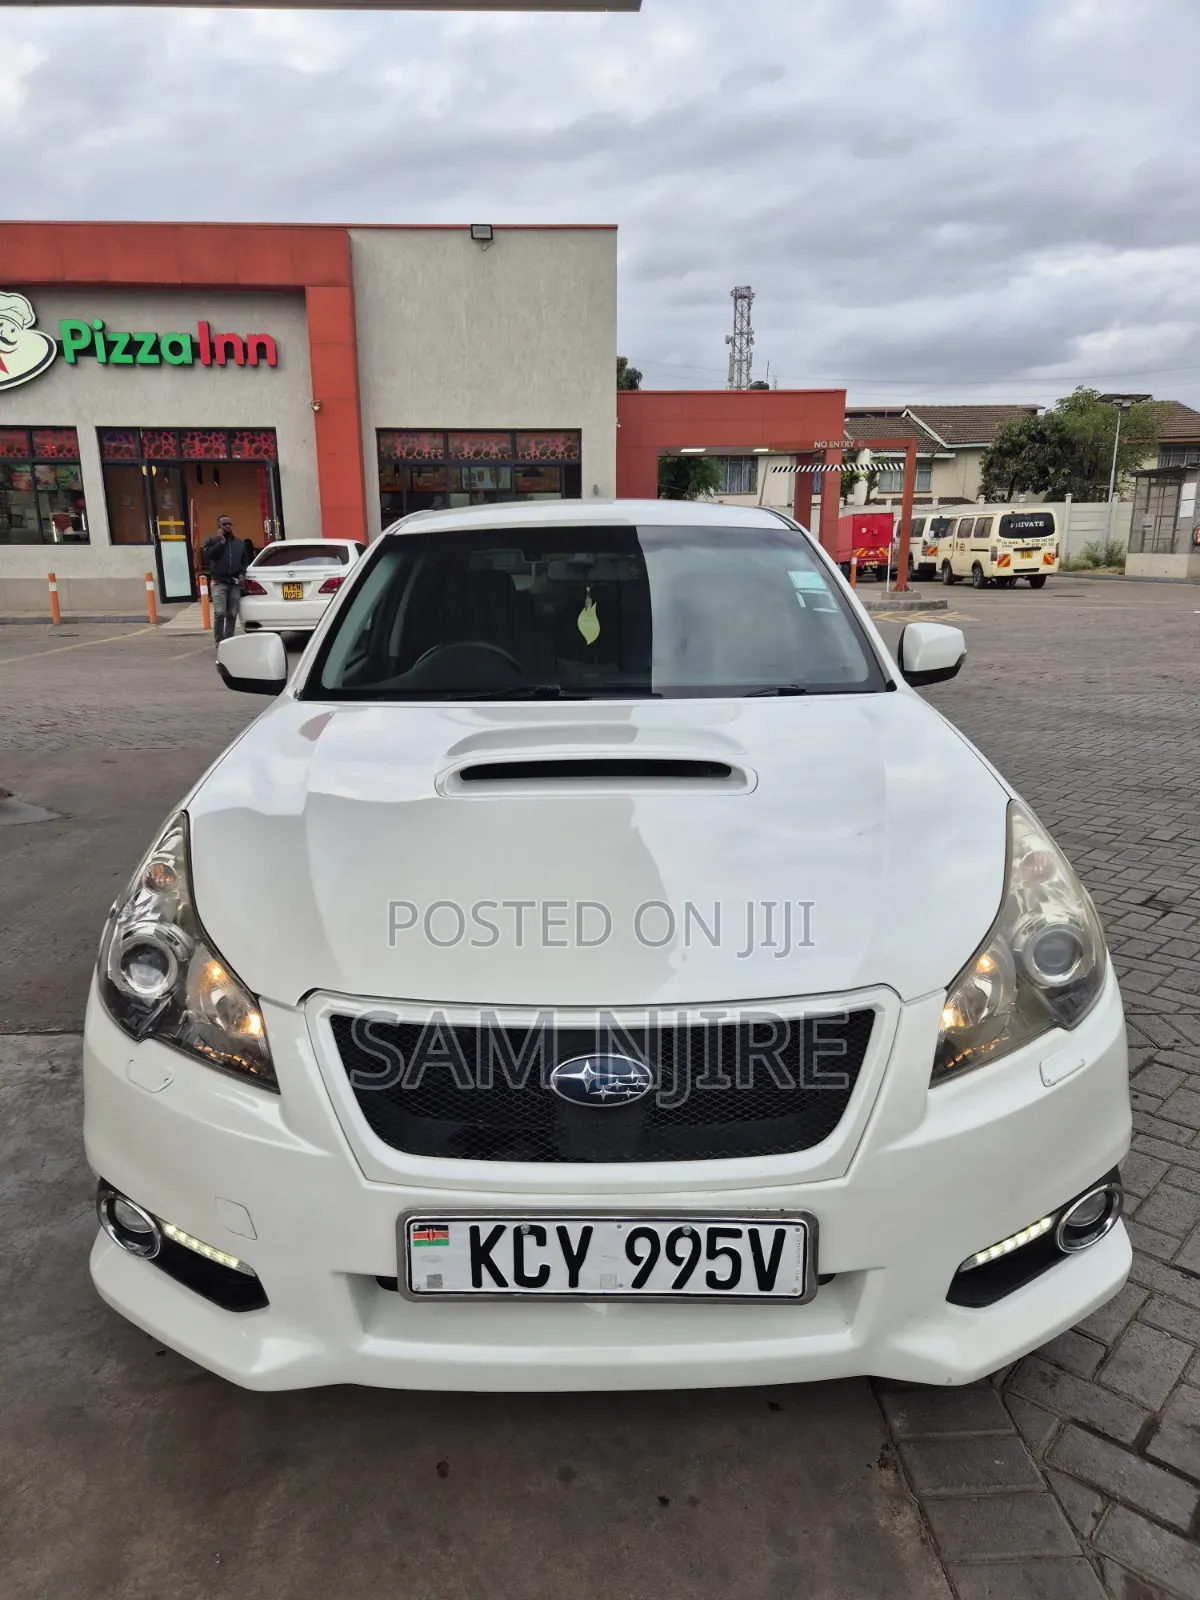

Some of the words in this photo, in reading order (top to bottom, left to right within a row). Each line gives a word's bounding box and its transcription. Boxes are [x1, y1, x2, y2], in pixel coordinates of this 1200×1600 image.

[814, 441, 828, 449] NO
[829, 440, 855, 448] ENTRY
[1009, 520, 1045, 528] PRIVATE
[469, 1224, 594, 1289] KCY
[625, 1226, 787, 1292] 995V
